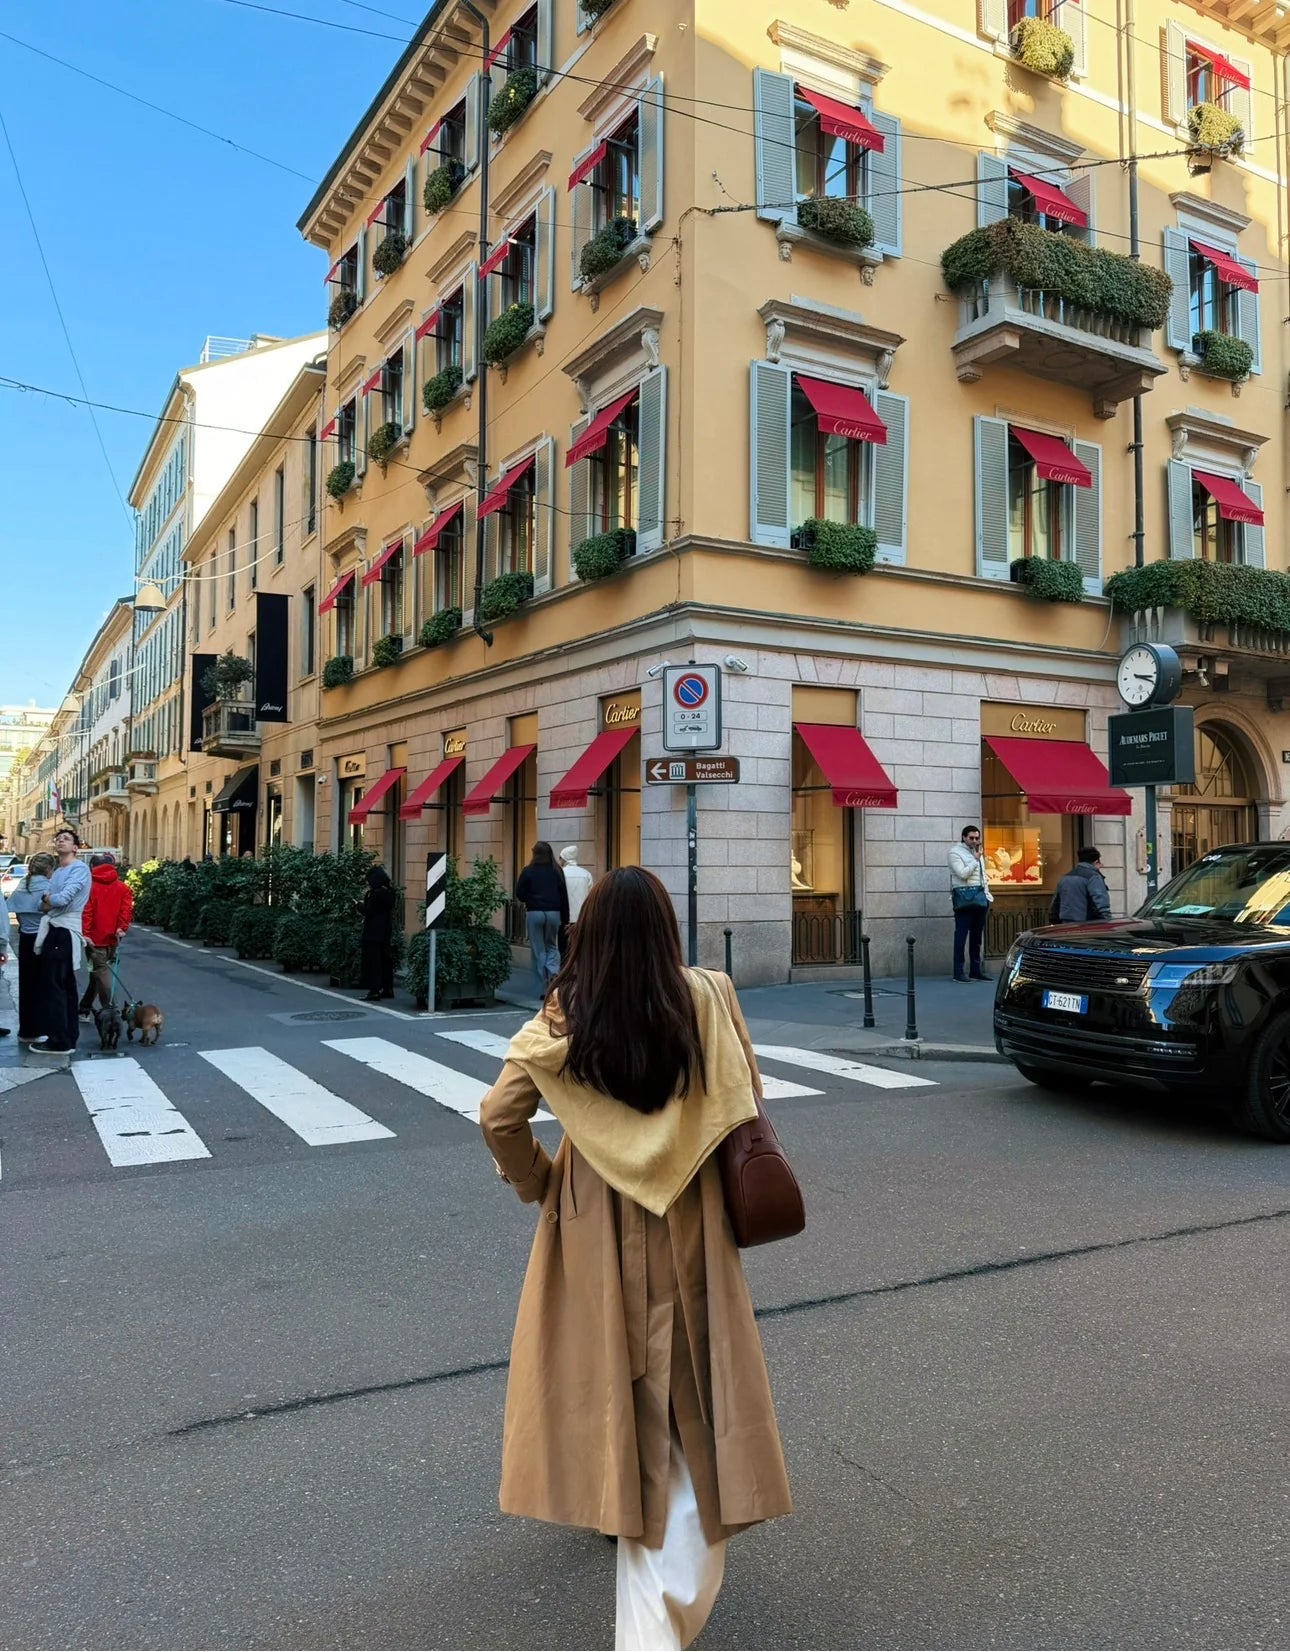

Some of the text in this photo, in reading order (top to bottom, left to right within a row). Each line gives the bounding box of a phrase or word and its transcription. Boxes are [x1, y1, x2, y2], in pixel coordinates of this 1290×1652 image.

[833, 125, 872, 146] Cartier
[1045, 202, 1077, 223] Cartier
[833, 420, 872, 439] Cartier
[1049, 467, 1080, 484] Cartier
[605, 704, 640, 724] Cartier
[1011, 712, 1057, 734] Cartier
[444, 738, 466, 754] Cartier
[696, 762, 726, 771] Bagatti
[696, 770, 733, 779] Valsecchi
[845, 791, 885, 806] Cartier
[1065, 799, 1098, 813] Cartier
